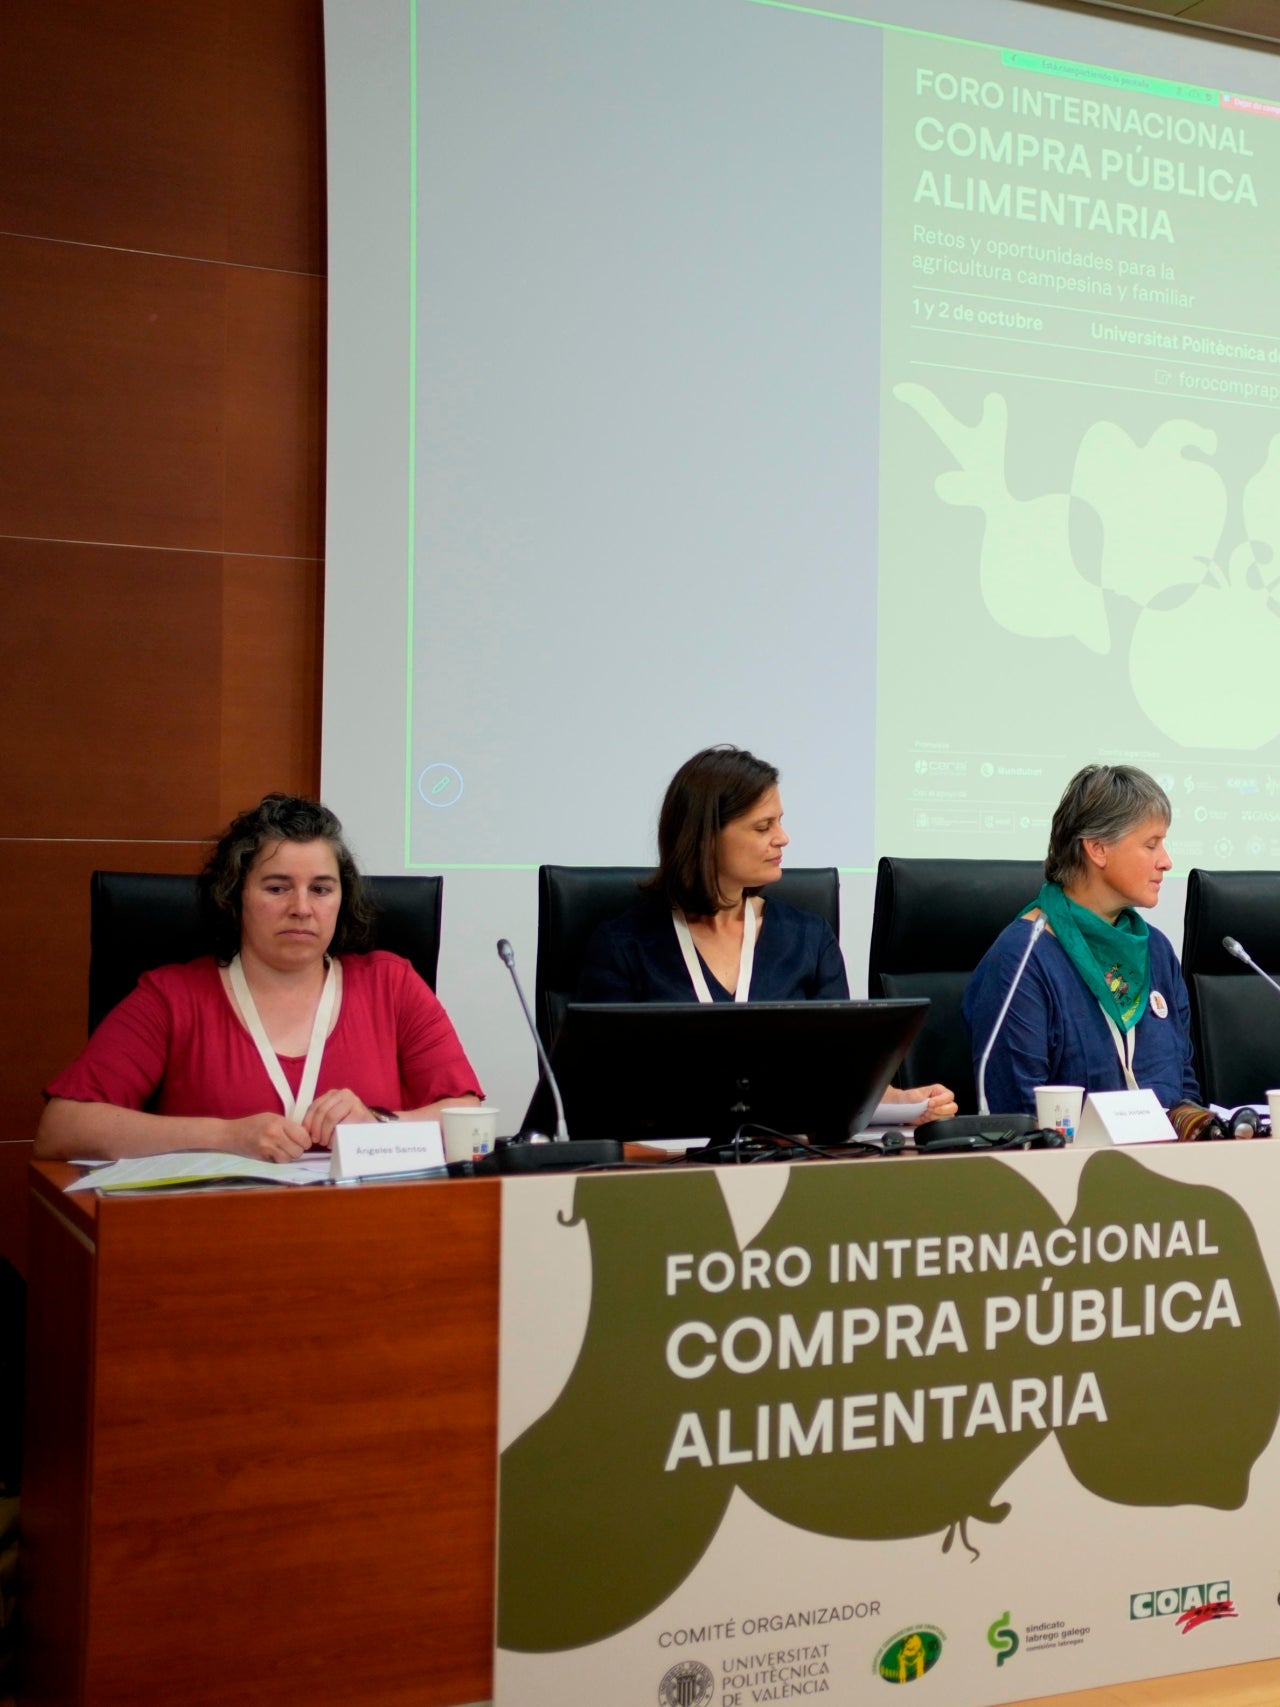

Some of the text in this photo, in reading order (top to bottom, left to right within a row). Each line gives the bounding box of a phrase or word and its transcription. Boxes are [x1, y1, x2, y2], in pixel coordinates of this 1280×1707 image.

[916, 68, 1254, 156] FORO INTERNACIONAL
[915, 117, 1258, 207] COMPRA PÚBLICA
[913, 170, 1175, 243] ALIMENTARIA
[912, 225, 1176, 282] Retos y oportunidades para la
[912, 253, 1196, 309] agricultura campesina y familiar
[912, 298, 1043, 332] 1 y 2 de octubre
[1092, 322, 1179, 351] Universitat
[1183, 336, 1266, 363] Politècnica
[666, 1218, 1219, 1296] FORO INTERNACIONAL
[665, 1277, 1241, 1379] COMPRA PÚBLICA
[664, 1371, 1109, 1472] ALIMENTARIA
[1131, 1581, 1230, 1619] COAG
[659, 1601, 881, 1648] COMITÉ ORGANIZADOR
[1026, 1621, 1066, 1634] sindicato
[1026, 1627, 1090, 1643] labrego galego
[722, 1662, 830, 1691] POLITÈCNICA
[723, 1644, 830, 1674] UNIVERSITAT
[722, 1679, 830, 1707] DE VALÈNCIA
